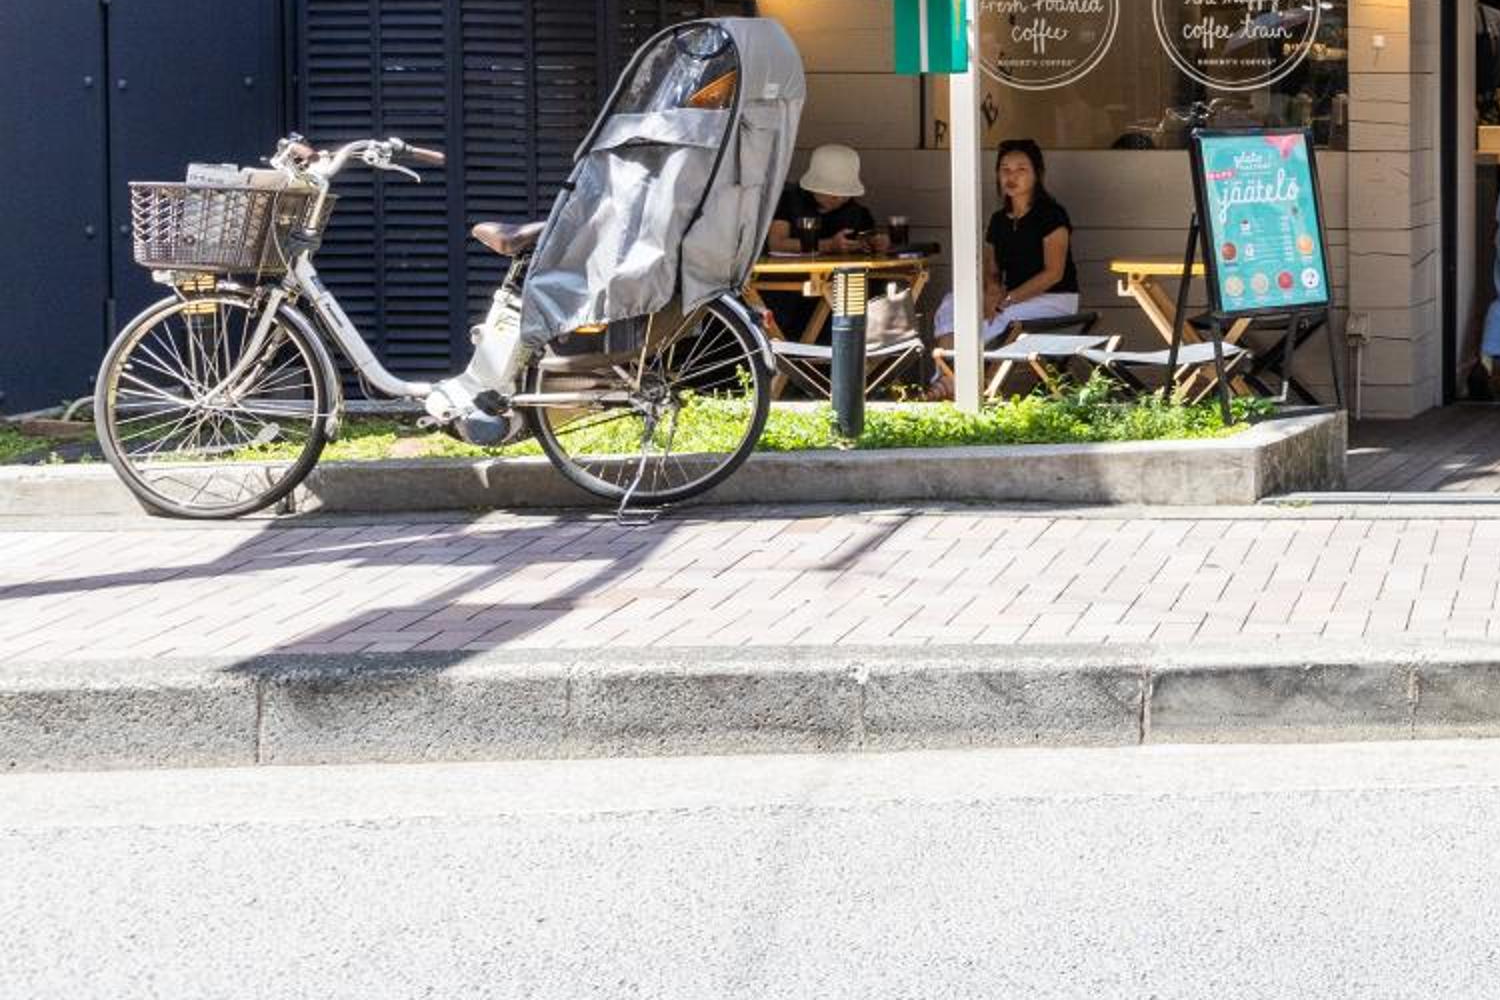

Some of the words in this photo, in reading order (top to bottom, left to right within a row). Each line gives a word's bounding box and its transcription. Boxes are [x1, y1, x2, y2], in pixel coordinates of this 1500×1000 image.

[1011, 17, 1070, 55] coffee
[1183, 16, 1233, 50] coffee
[1239, 12, 1293, 40] train
